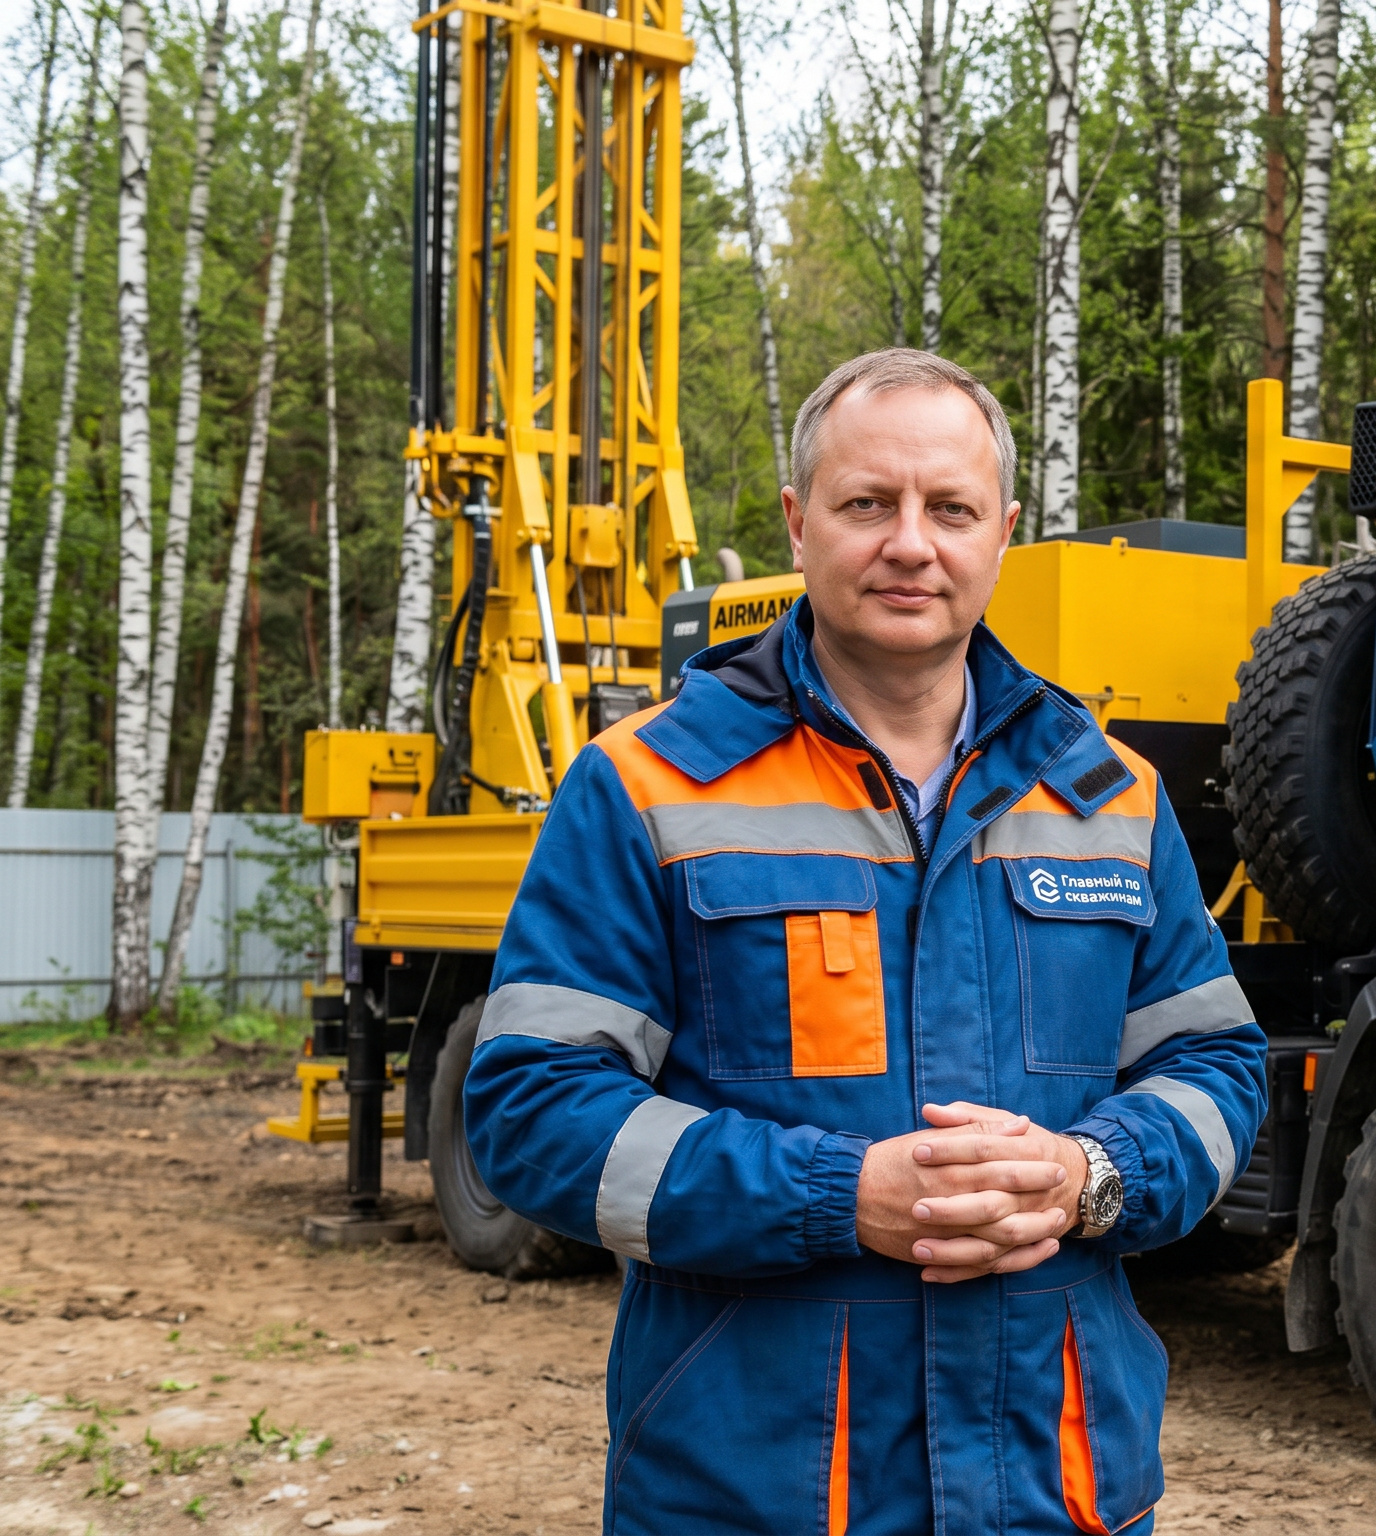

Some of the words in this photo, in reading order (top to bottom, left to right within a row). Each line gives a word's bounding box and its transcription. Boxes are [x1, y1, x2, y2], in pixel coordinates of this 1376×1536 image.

[1061, 873, 1123, 889] Главный
[1125, 879, 1140, 891] по
[1065, 891, 1142, 906] скважинам
